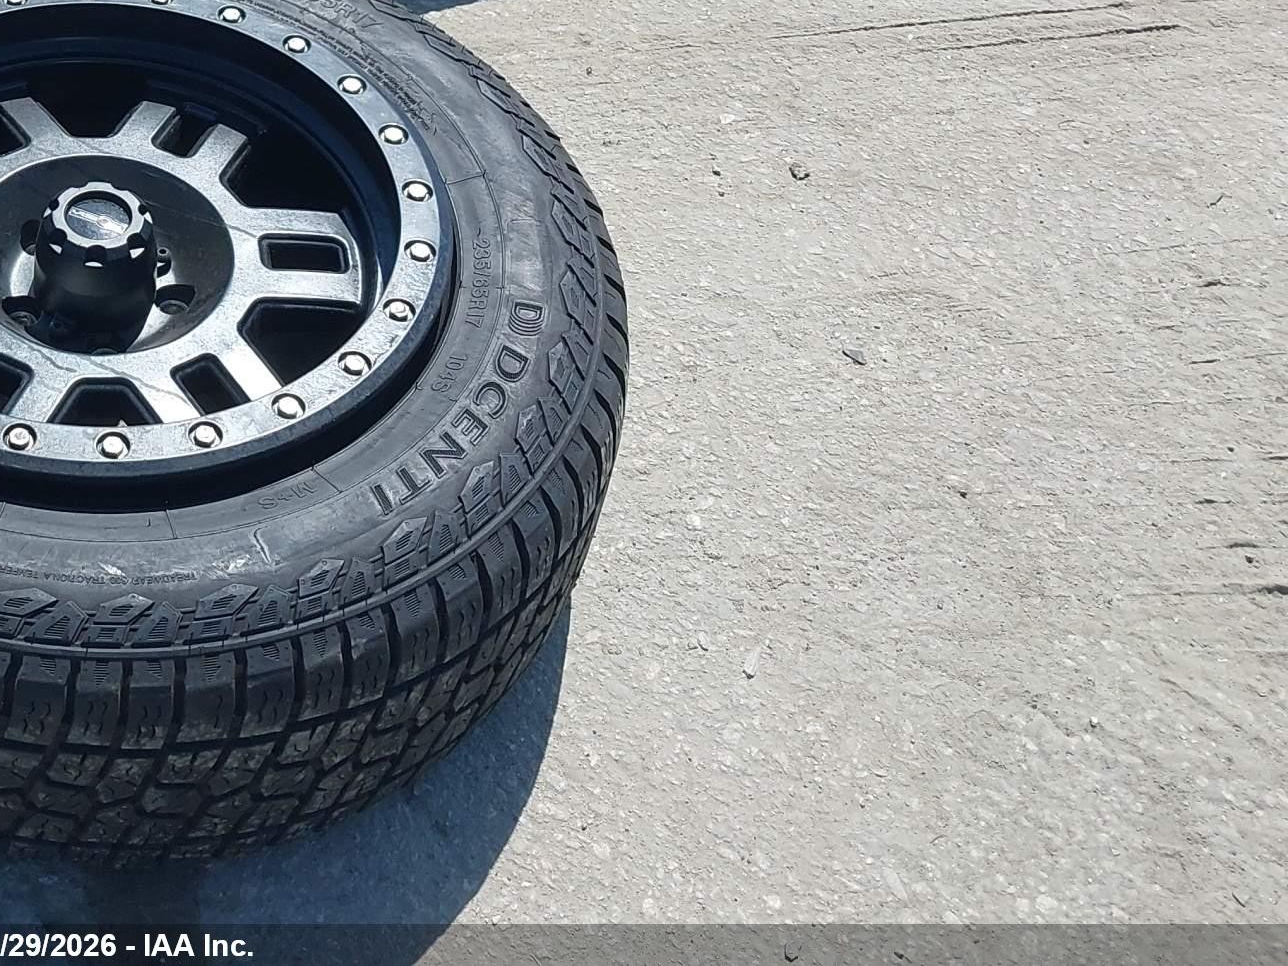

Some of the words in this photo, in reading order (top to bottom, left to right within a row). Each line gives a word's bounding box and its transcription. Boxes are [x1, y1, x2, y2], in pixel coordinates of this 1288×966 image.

[430, 353, 468, 394] 104S
[371, 343, 530, 516] DCENTI
[257, 481, 318, 510] M+S
[135, 568, 198, 586] TREADWEAR
